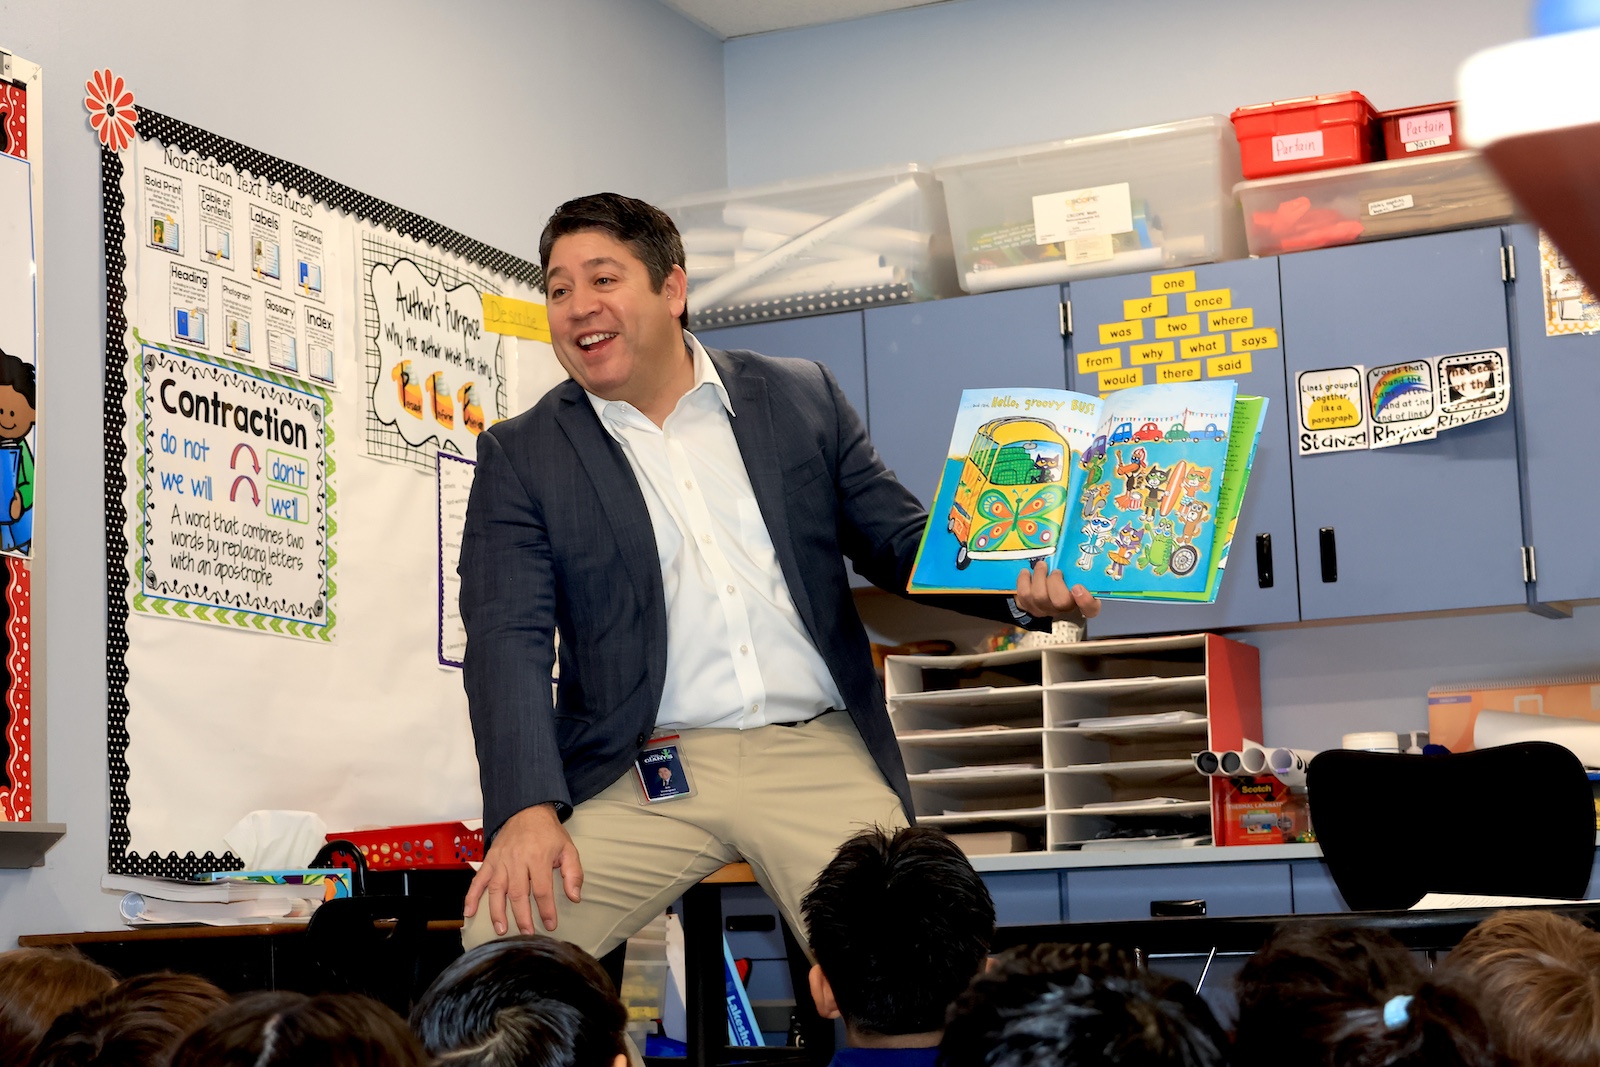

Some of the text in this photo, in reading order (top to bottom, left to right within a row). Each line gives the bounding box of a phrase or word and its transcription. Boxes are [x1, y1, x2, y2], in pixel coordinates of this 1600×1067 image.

[1406, 120, 1445, 137] Partain
[1275, 138, 1316, 156] Partain
[1413, 139, 1436, 150] Yarn
[145, 175, 182, 195] Bold Print
[163, 149, 313, 218] Nonfiction Text Features
[201, 189, 230, 208] Table of
[201, 200, 231, 220] Contents
[250, 207, 279, 230] Labels
[294, 225, 322, 245] Captions
[171, 265, 208, 289] Heading
[1163, 278, 1185, 290] one
[1140, 302, 1152, 313] of
[1194, 295, 1223, 308] once
[265, 298, 296, 320] Glossary
[306, 309, 332, 330] Index
[396, 281, 481, 354] Author's Purpose
[1212, 314, 1248, 327] where
[1109, 327, 1132, 338] was
[1167, 321, 1187, 332] two
[384, 321, 403, 356] Why
[406, 327, 418, 351] the
[421, 334, 441, 359] author
[464, 348, 475, 371] the
[1189, 340, 1217, 353] what
[1241, 335, 1268, 348] says
[1142, 348, 1164, 360] why
[1085, 355, 1113, 368] from
[1217, 359, 1242, 372] said
[1163, 366, 1194, 379] there
[1373, 363, 1424, 376] Words that
[1103, 373, 1137, 386] would
[1407, 375, 1422, 384] the
[1301, 381, 1358, 394] Lines grouped
[991, 396, 1019, 409] Hello,
[1025, 399, 1065, 411] groovy
[1312, 393, 1350, 404] together,
[1402, 399, 1412, 408] at
[160, 378, 308, 450] Contraction
[1321, 404, 1335, 413] like
[1396, 412, 1405, 420] of
[1408, 409, 1428, 419] lines
[1312, 414, 1353, 426] paragraph
[160, 428, 210, 462] do not
[1301, 431, 1366, 451] Stanza
[272, 457, 306, 486] don't
[160, 470, 213, 501] we will
[271, 497, 299, 521] we'll
[170, 504, 305, 550] A word that combines two
[170, 530, 304, 572] words by replacing letters
[170, 551, 273, 591] with an apostrophe
[1242, 785, 1271, 793] Scotch
